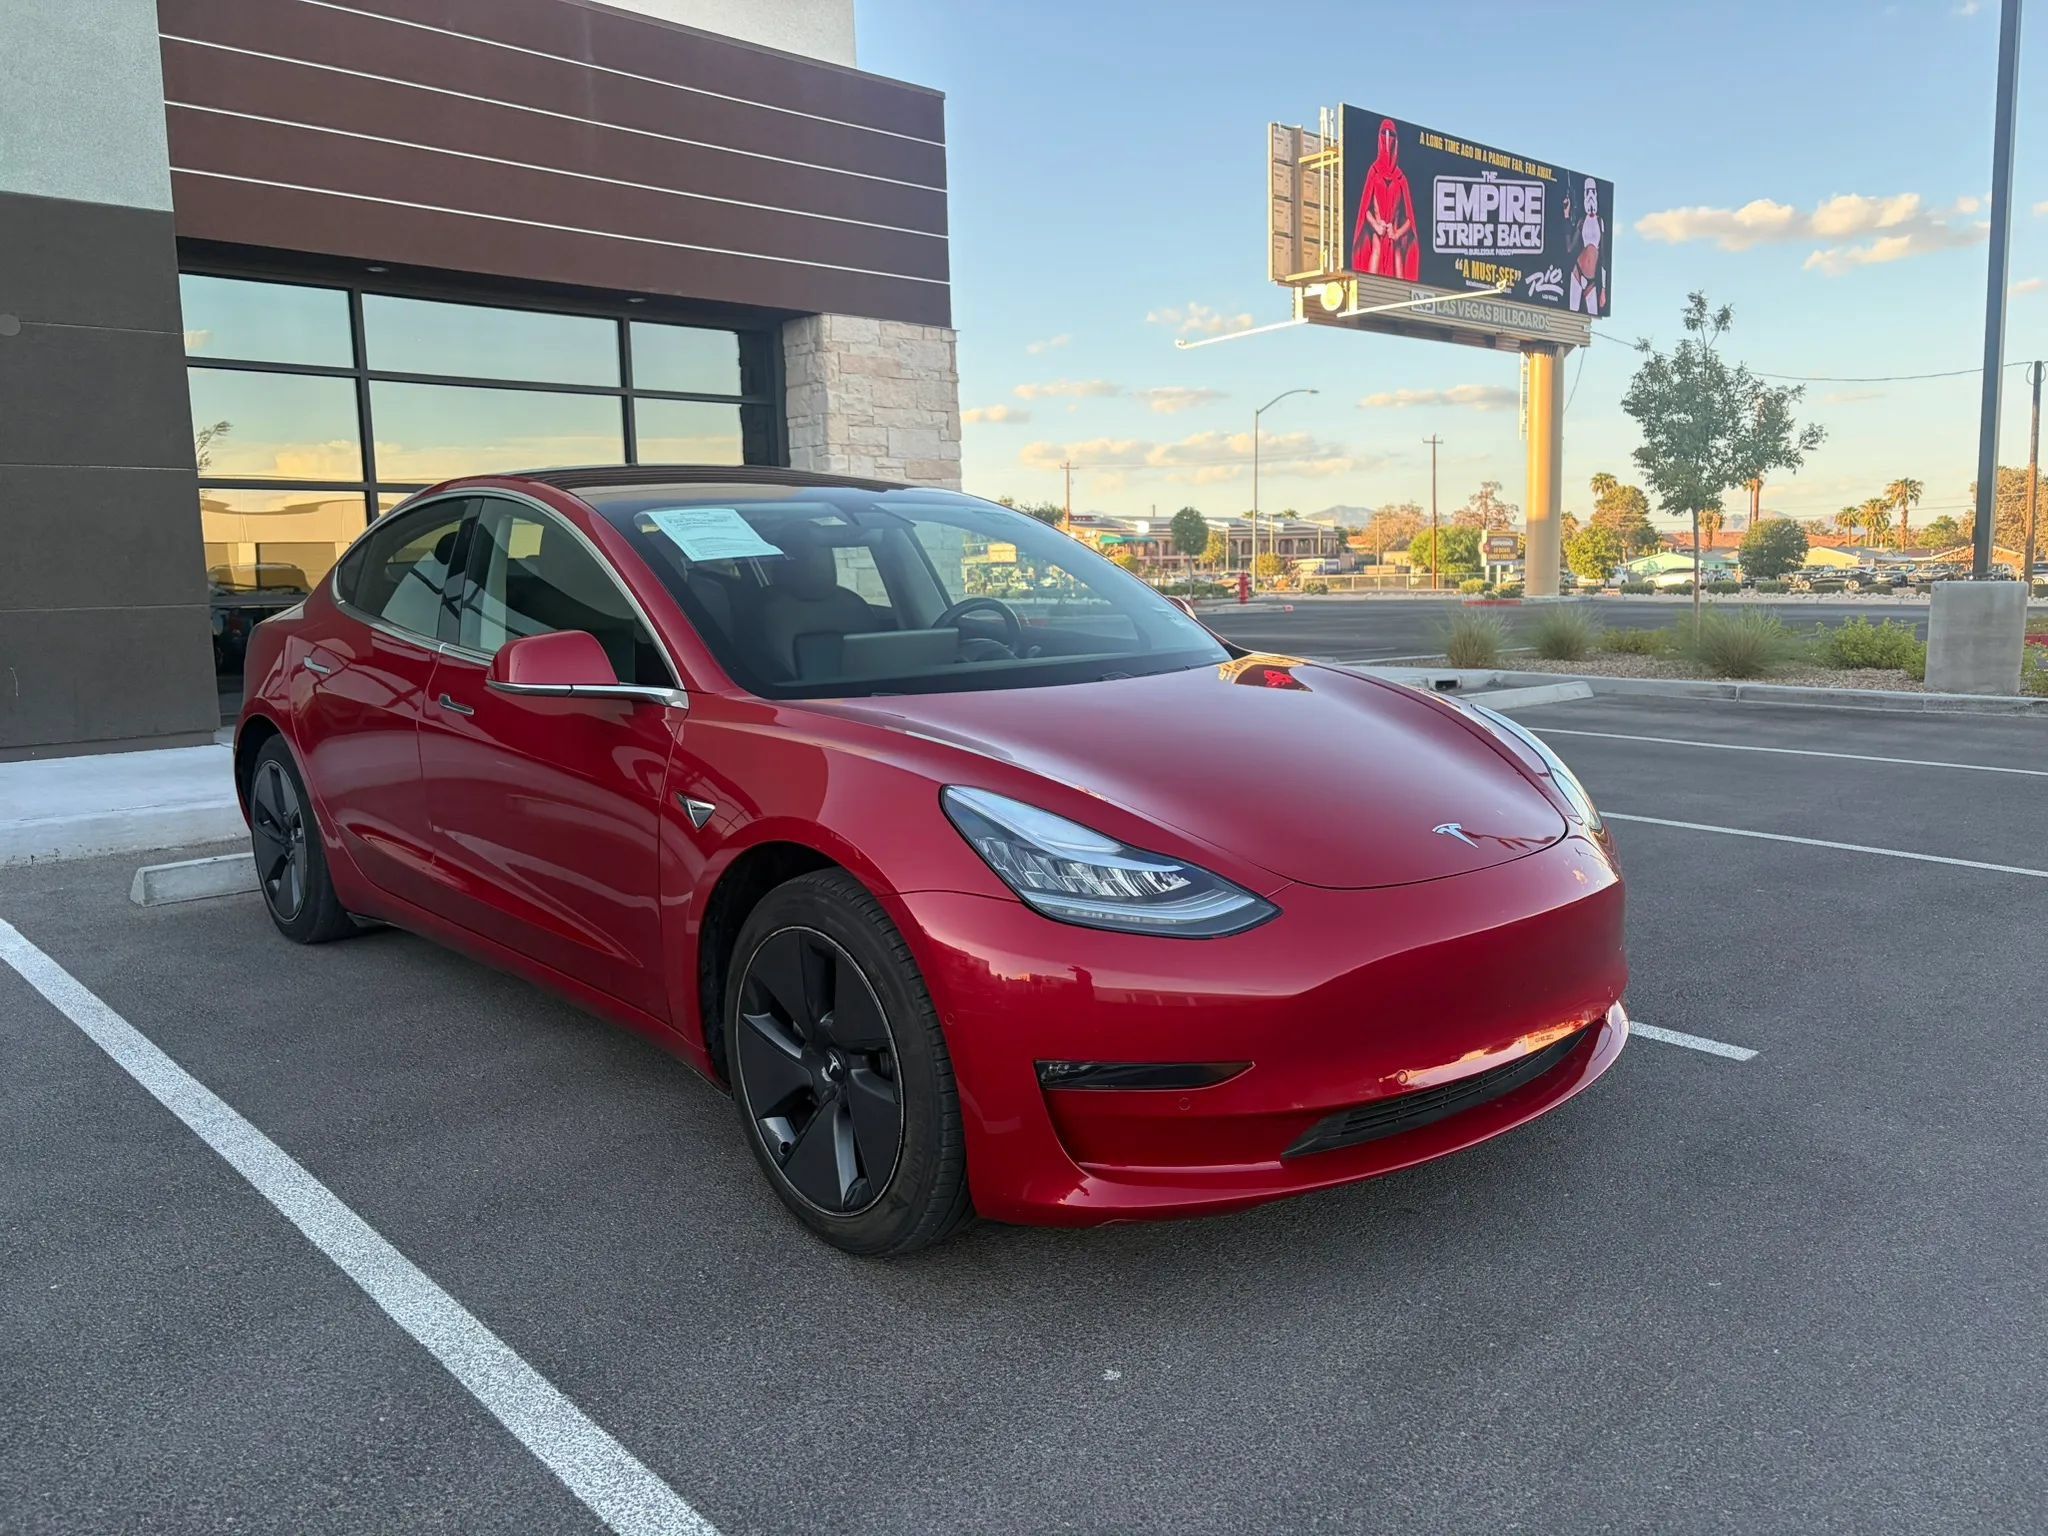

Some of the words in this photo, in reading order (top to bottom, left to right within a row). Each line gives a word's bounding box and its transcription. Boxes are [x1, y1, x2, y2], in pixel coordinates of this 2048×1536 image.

[1419, 131, 1425, 145] A
[1426, 133, 1443, 150] LONG
[1444, 138, 1460, 155] TIME
[1461, 143, 1474, 159] AGO
[1474, 147, 1482, 161] IN
[1482, 150, 1488, 163] A
[1488, 151, 1511, 169] PARODY
[1511, 157, 1524, 174] FAR,
[1525, 162, 1536, 175] FAR
[1481, 171, 1498, 183] THE
[1436, 182, 1542, 224] EMPIRE
[1437, 222, 1494, 247] STRIPS
[1498, 224, 1541, 248] BACK
[1437, 299, 1457, 315] LAS
[1458, 301, 1491, 321] VEGAS
[1493, 306, 1551, 330] BILLBOARDS
